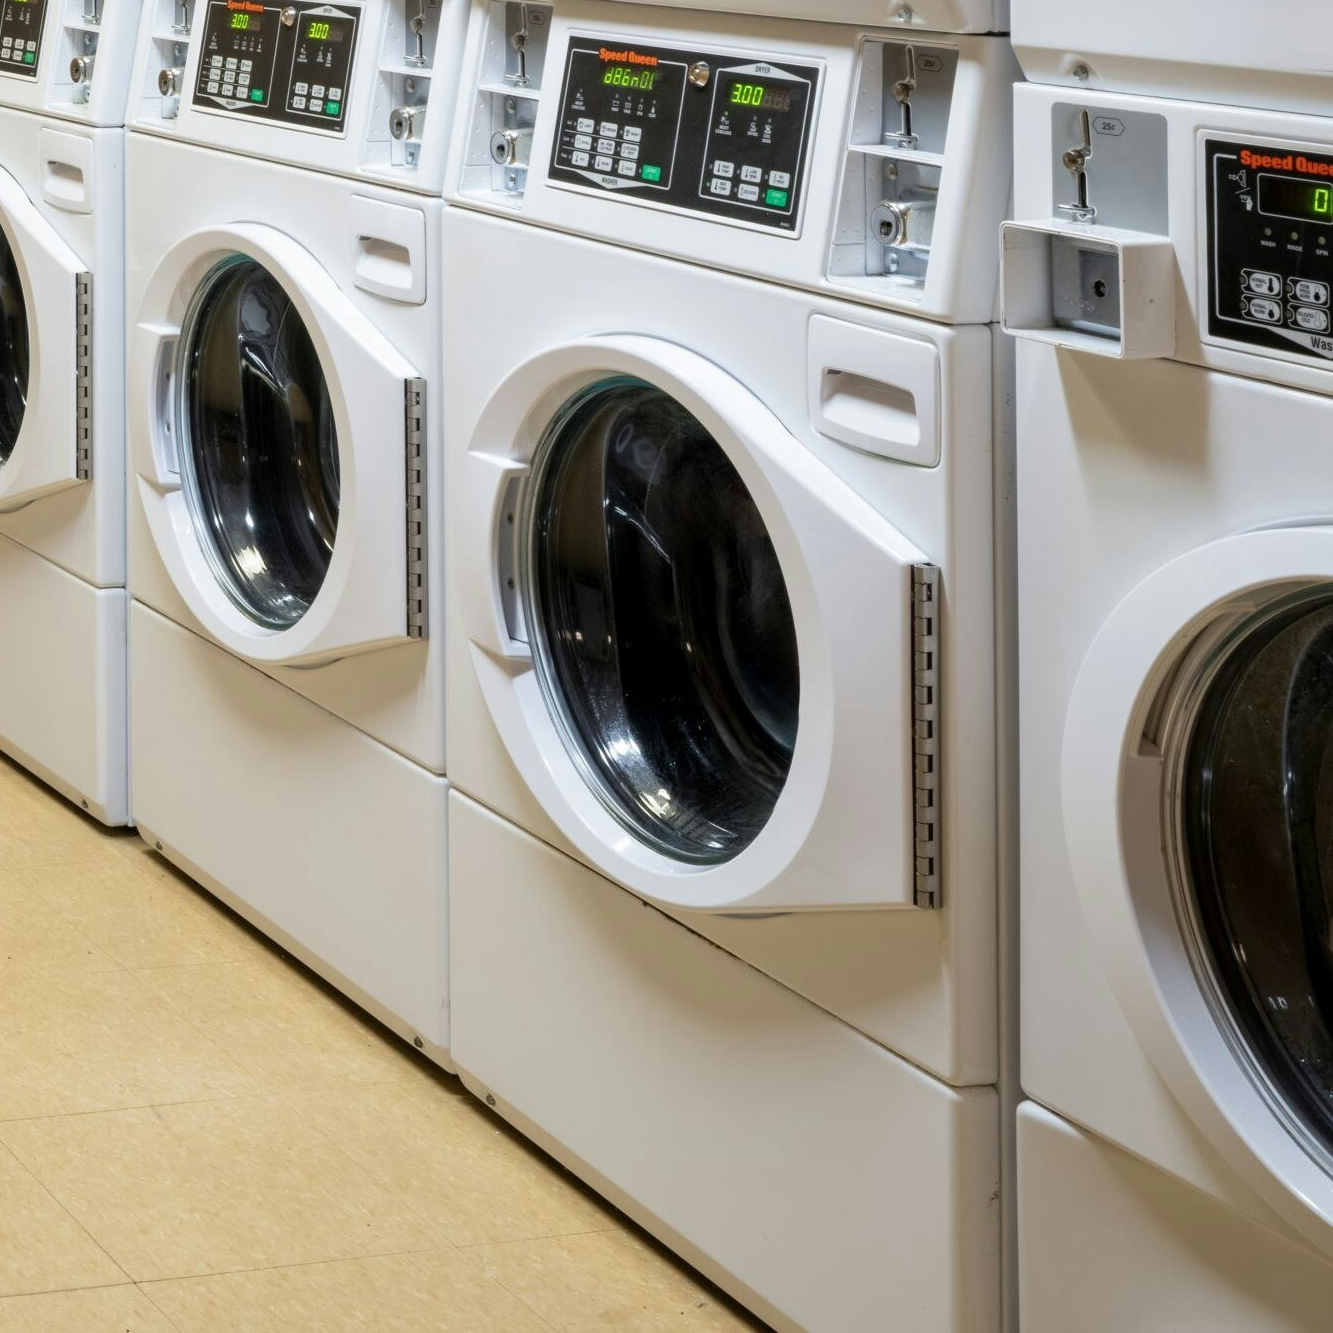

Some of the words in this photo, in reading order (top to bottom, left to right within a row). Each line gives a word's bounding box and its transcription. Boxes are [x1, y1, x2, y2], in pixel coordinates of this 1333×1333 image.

[599, 48, 628, 62] Speed
[628, 51, 658, 66] Queen
[754, 65, 771, 74] DRYER
[731, 83, 763, 106] 3.00
[1240, 149, 1293, 170] Speed
[1314, 188, 1329, 212] 0
[1310, 336, 1333, 351] Was
